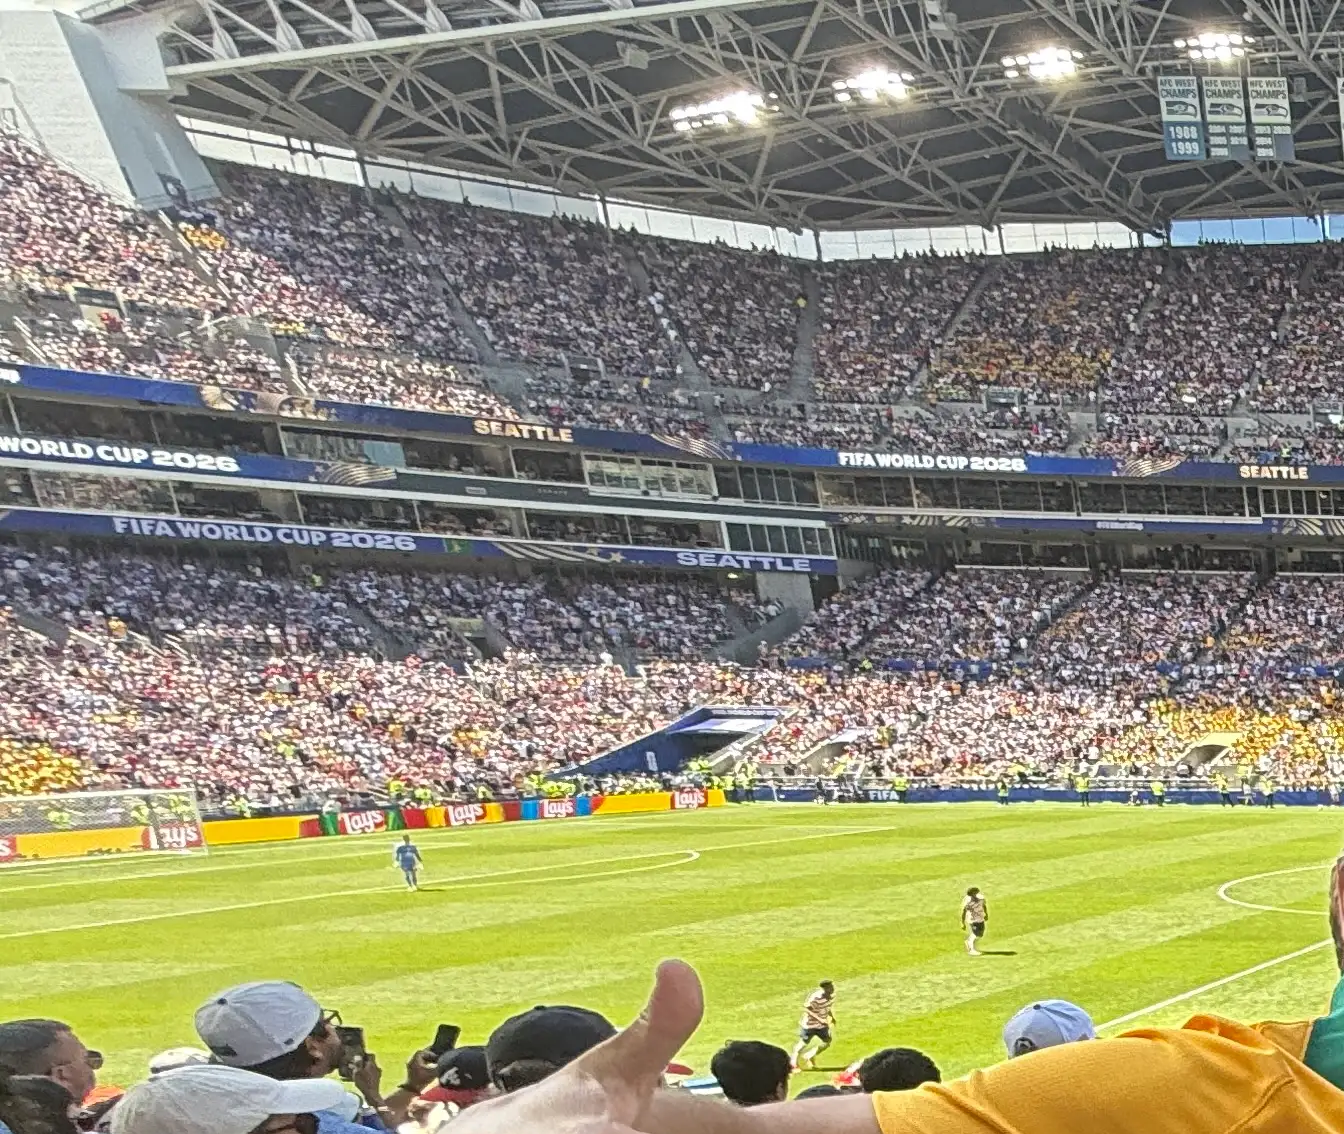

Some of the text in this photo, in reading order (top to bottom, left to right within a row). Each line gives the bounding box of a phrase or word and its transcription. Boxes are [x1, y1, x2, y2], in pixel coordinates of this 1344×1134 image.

[1161, 89, 1196, 99] CHAMPS
[1205, 89, 1242, 99] CHAMPS
[1251, 90, 1287, 99] CHAMPS
[1169, 126, 1198, 139] 1988
[1172, 141, 1199, 155] 1999
[473, 420, 574, 443] SEATTLE
[0, 437, 240, 471] WORLD CUP 2026
[838, 452, 875, 468] FIFA
[876, 454, 934, 469] WORLD
[936, 456, 968, 470] CUP
[1240, 465, 1308, 480] SEATTLE
[112, 518, 417, 551] FIFA WORLD CUP 2026
[677, 552, 812, 572] SEATTLE
[869, 790, 900, 801] FIFA
